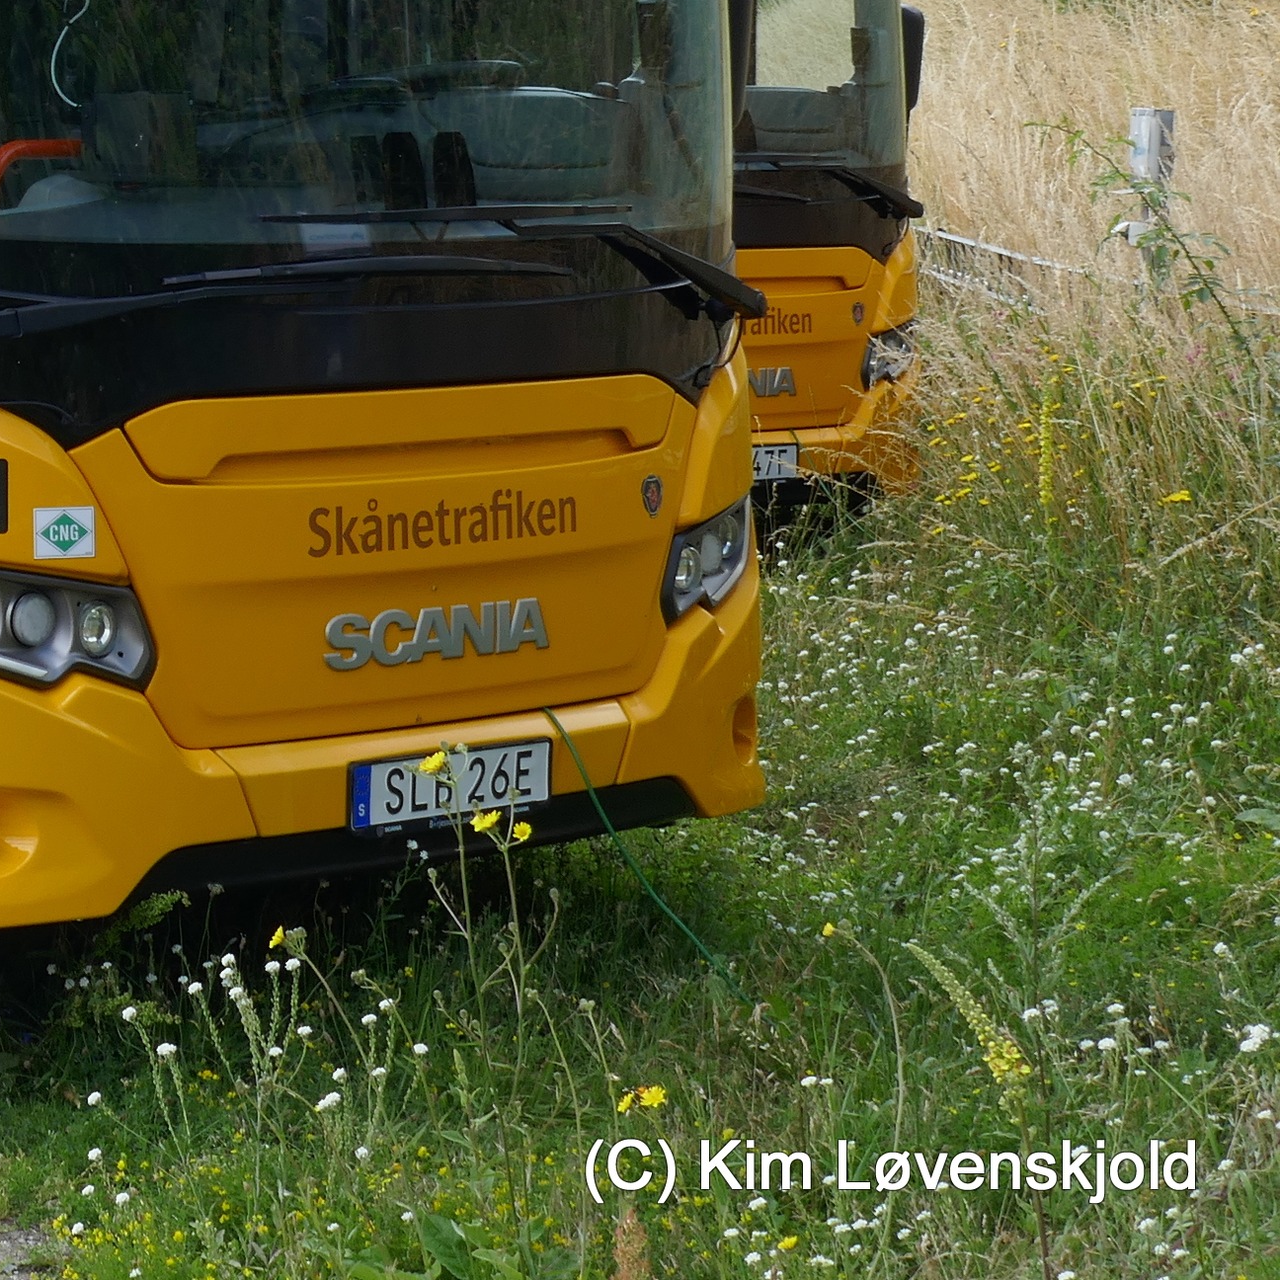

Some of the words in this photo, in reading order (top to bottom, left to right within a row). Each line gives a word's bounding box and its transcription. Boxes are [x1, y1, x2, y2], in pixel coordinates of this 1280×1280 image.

[49, 524, 79, 541] CNG
[307, 488, 577, 559] Skånetrafiken
[322, 596, 550, 672] SCANIA
[467, 749, 533, 804] 26E
[357, 803, 366, 818] S
